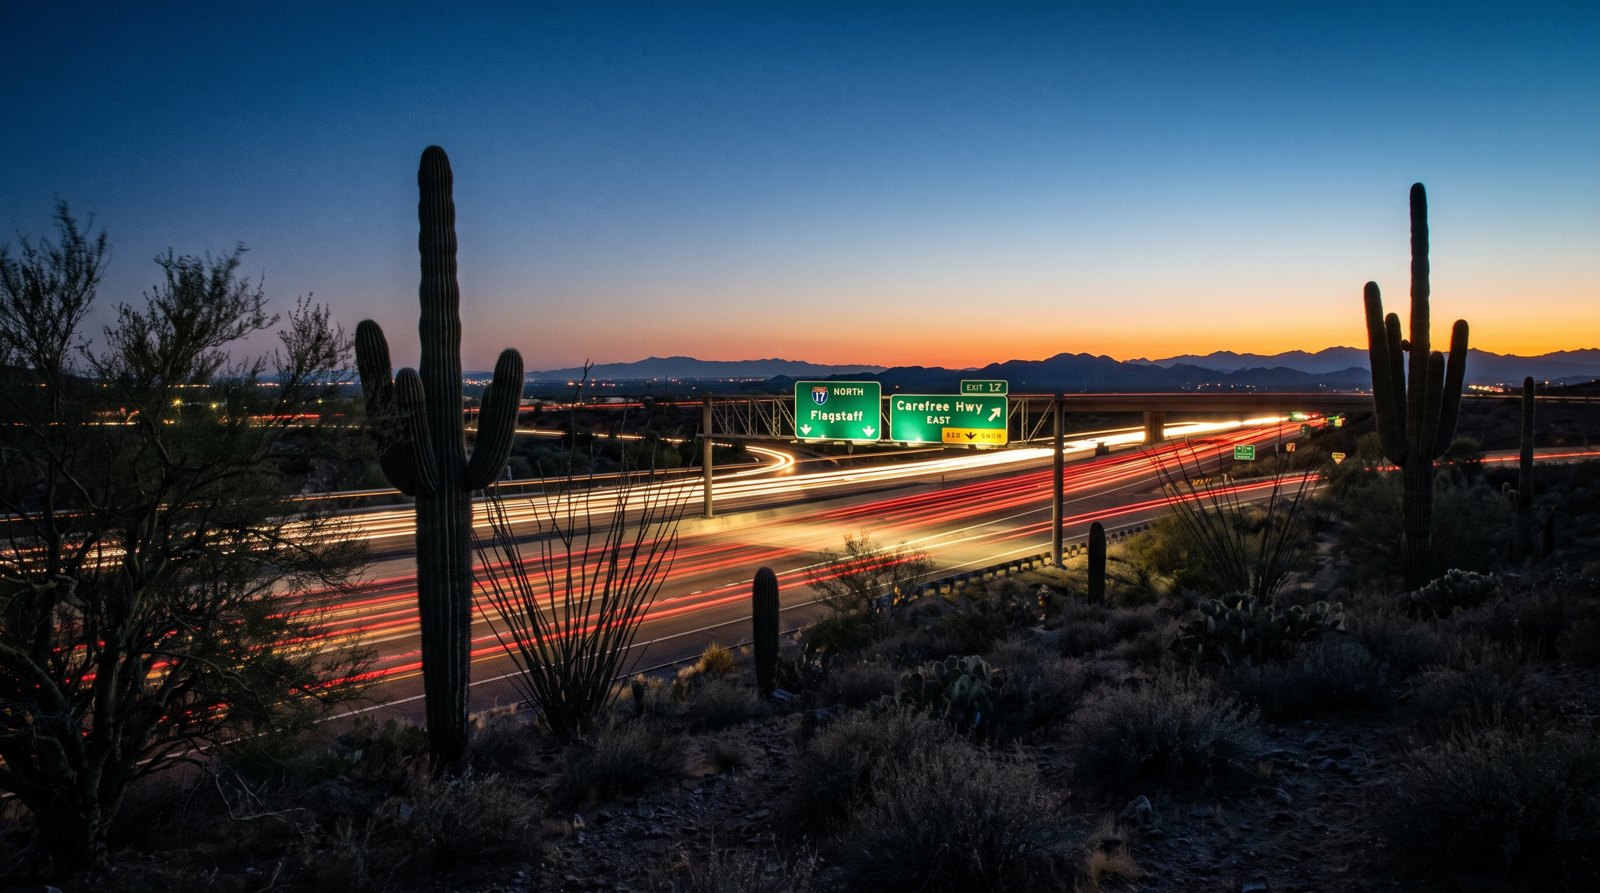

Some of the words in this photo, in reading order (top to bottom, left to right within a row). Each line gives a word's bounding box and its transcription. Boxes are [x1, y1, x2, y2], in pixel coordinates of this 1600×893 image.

[815, 392, 825, 402] 17
[834, 388, 864, 396] NORTH
[896, 400, 949, 411] Carefree
[956, 401, 983, 414] Hwy
[811, 410, 863, 423] Flagstaff
[927, 416, 950, 424] EAST
